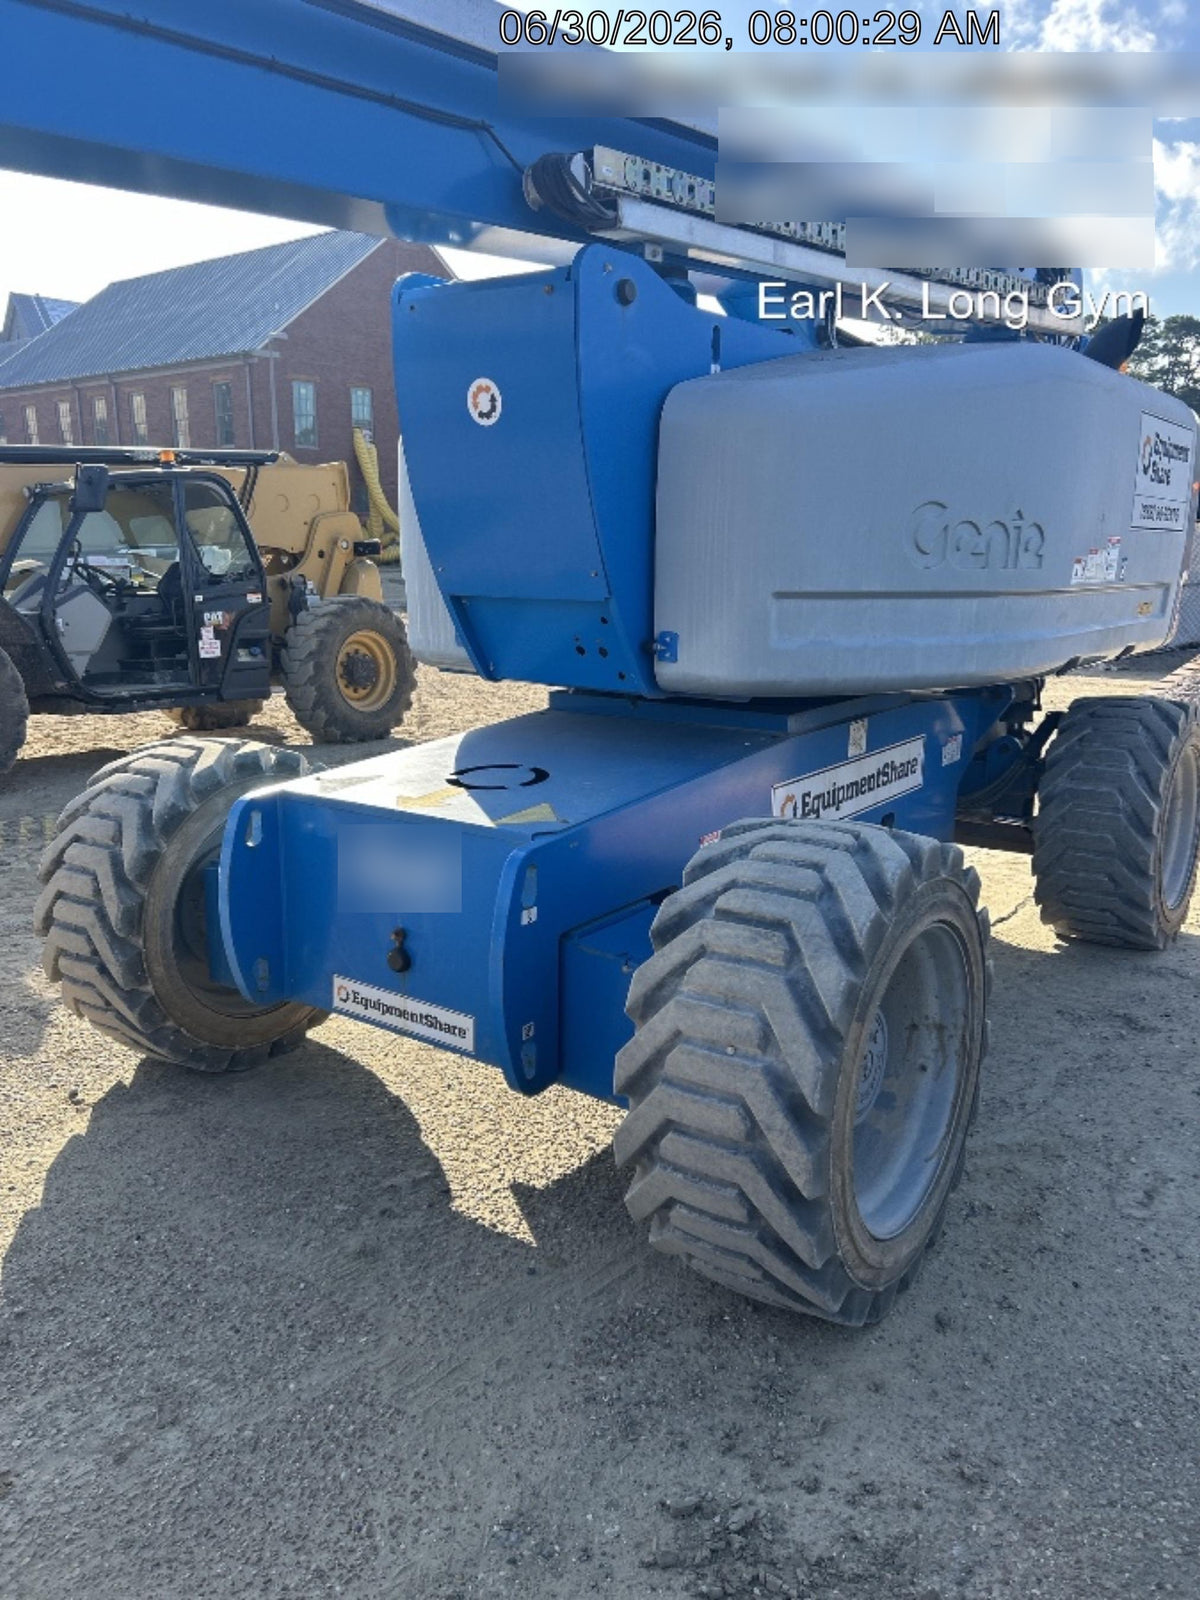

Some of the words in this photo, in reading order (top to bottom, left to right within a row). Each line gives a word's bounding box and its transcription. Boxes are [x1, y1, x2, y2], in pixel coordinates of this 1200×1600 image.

[911, 500, 1045, 569] Genie
[801, 757, 918, 818] EquipmentShare
[351, 989, 468, 1040] EquipmentShare
